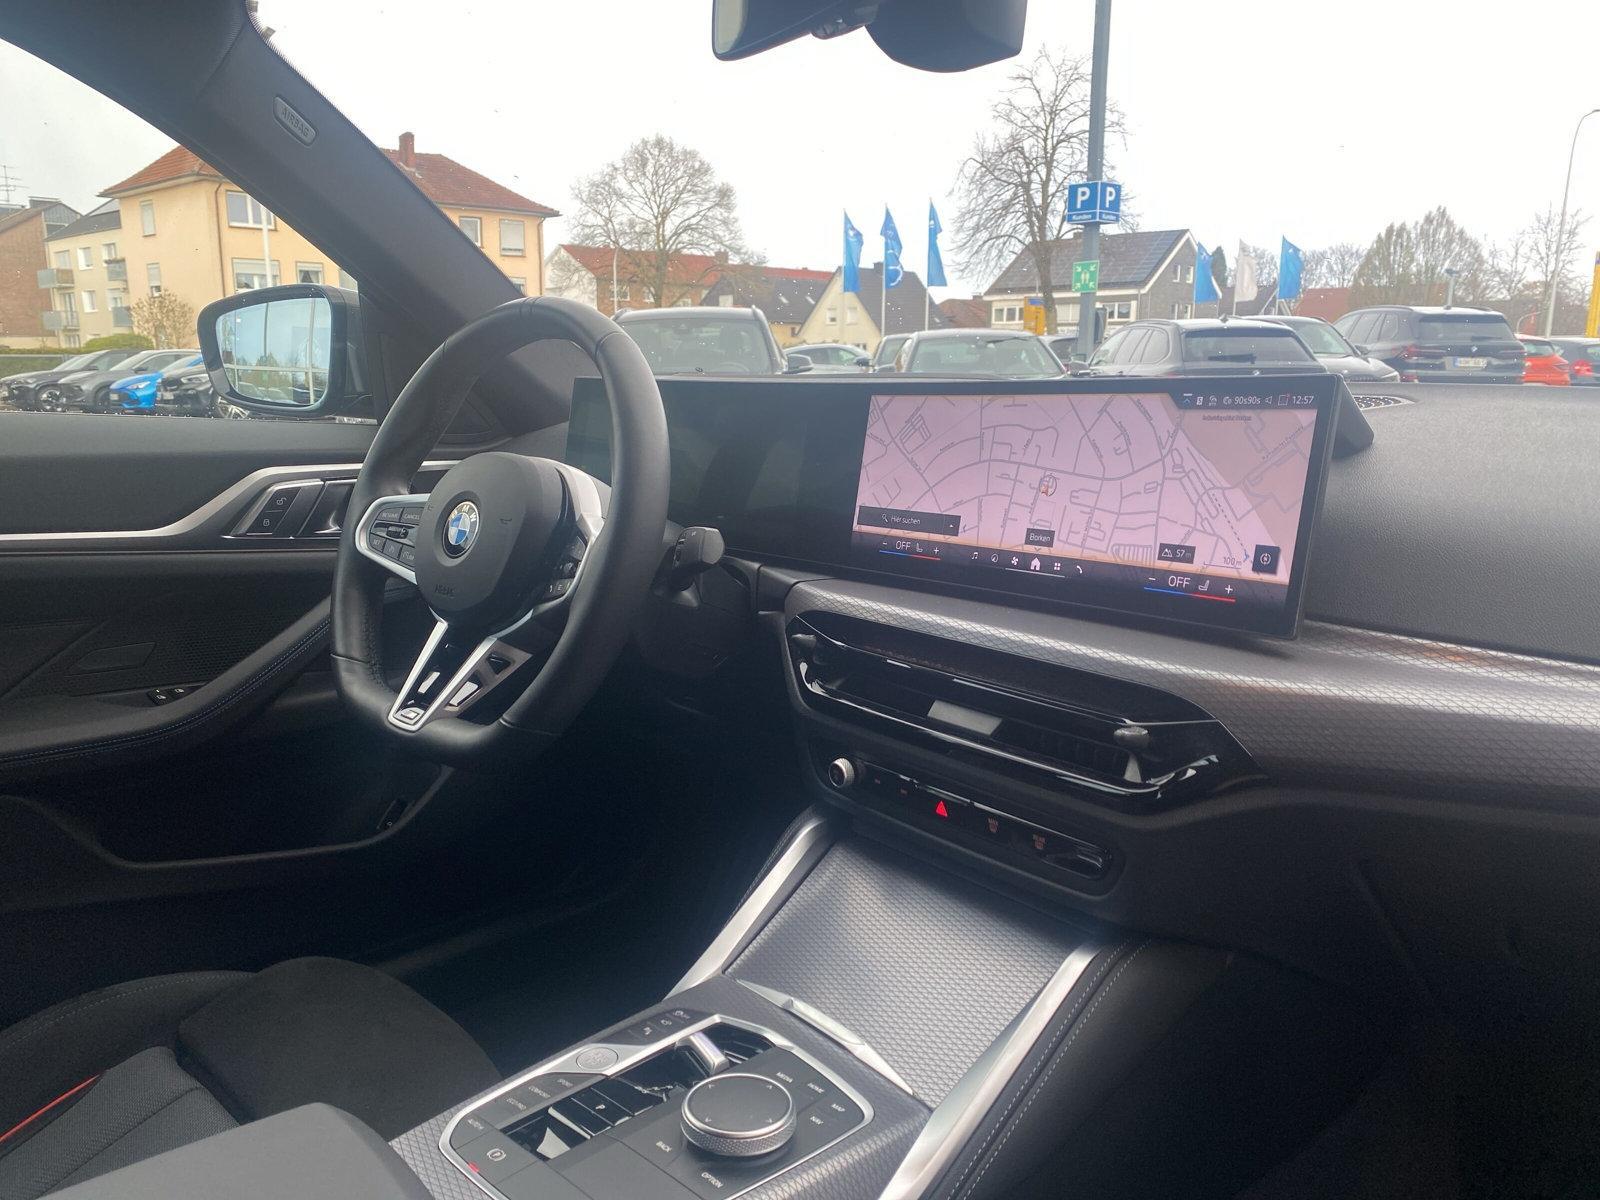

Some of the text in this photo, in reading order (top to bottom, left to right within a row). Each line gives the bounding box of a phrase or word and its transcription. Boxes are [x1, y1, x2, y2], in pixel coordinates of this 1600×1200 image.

[280, 104, 310, 139] AIRBAG
[1077, 187, 1090, 208] P
[1105, 186, 1116, 208] P
[1234, 396, 1261, 405] 90s90s
[1292, 395, 1315, 405] 12:57
[1029, 532, 1051, 542] Borken
[895, 540, 912, 550] OFF
[1176, 549, 1186, 558] 57
[1223, 556, 1236, 566] 100
[1168, 575, 1191, 588] OFF
[655, 1140, 673, 1153] BACK
